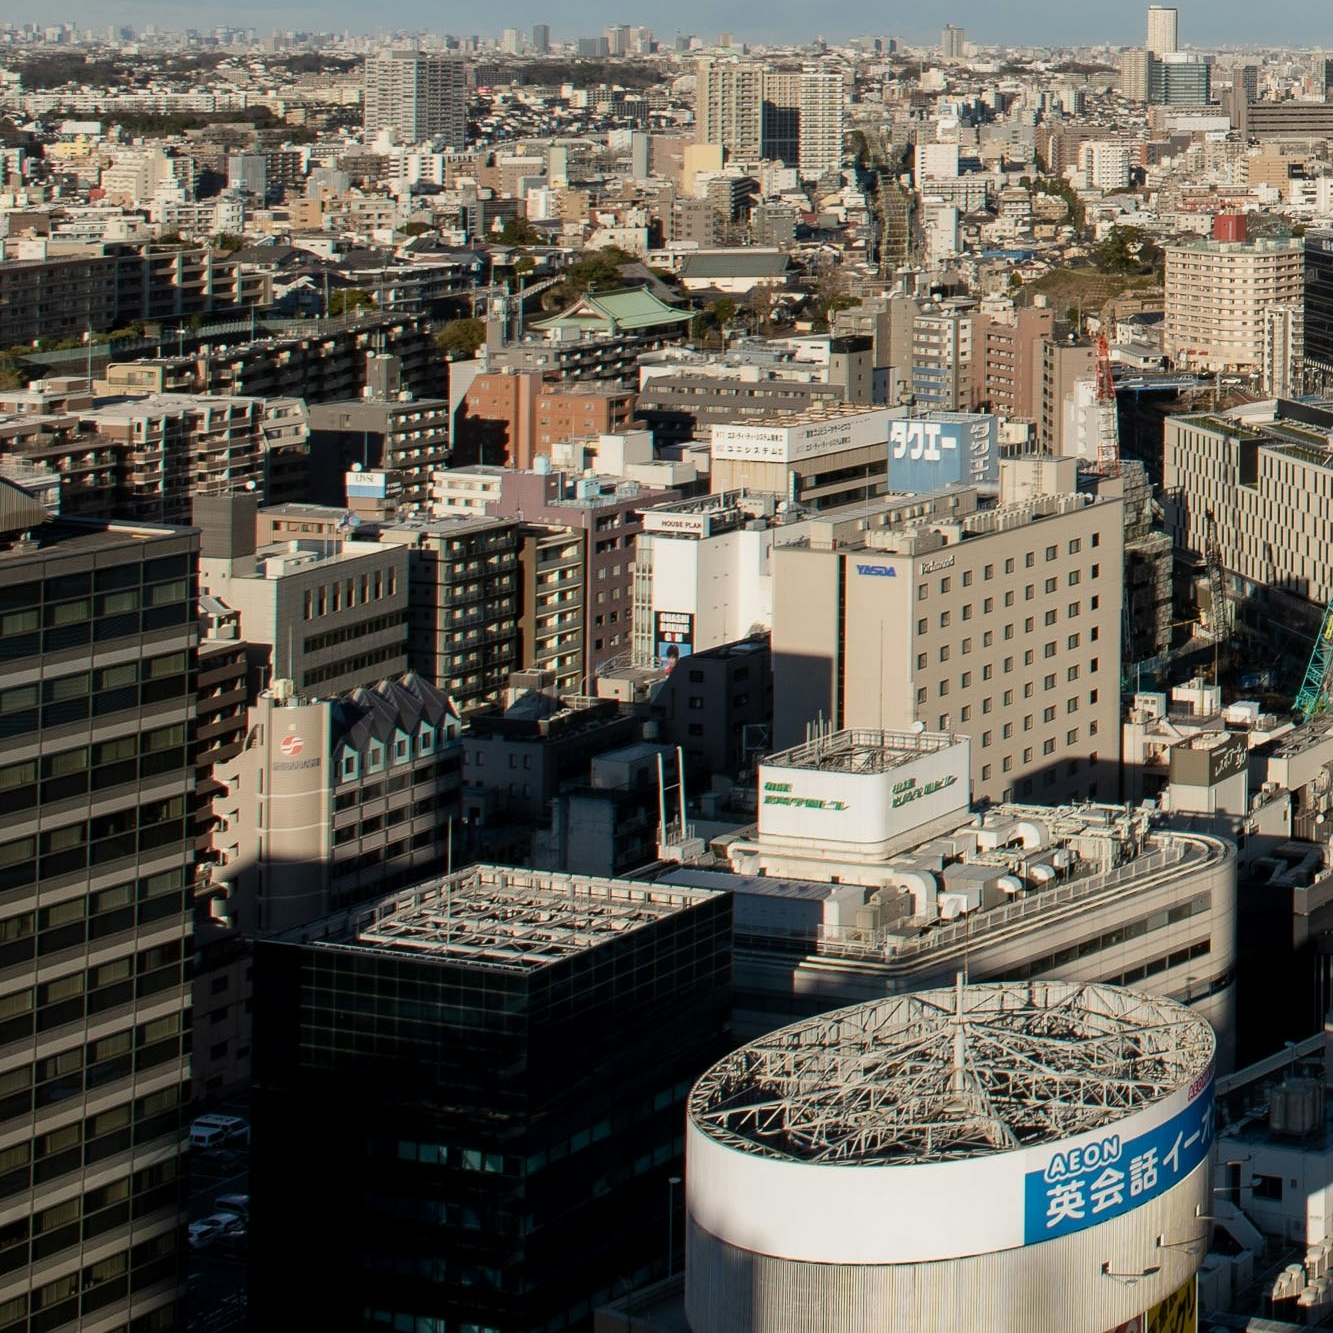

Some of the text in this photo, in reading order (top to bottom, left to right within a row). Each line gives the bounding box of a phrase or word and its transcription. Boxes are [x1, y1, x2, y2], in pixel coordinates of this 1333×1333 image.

[890, 421, 957, 461] タクエー
[661, 520, 683, 528] HOUSE
[660, 613, 690, 623] OHASHI
[1046, 1135, 1120, 1180] AEON
